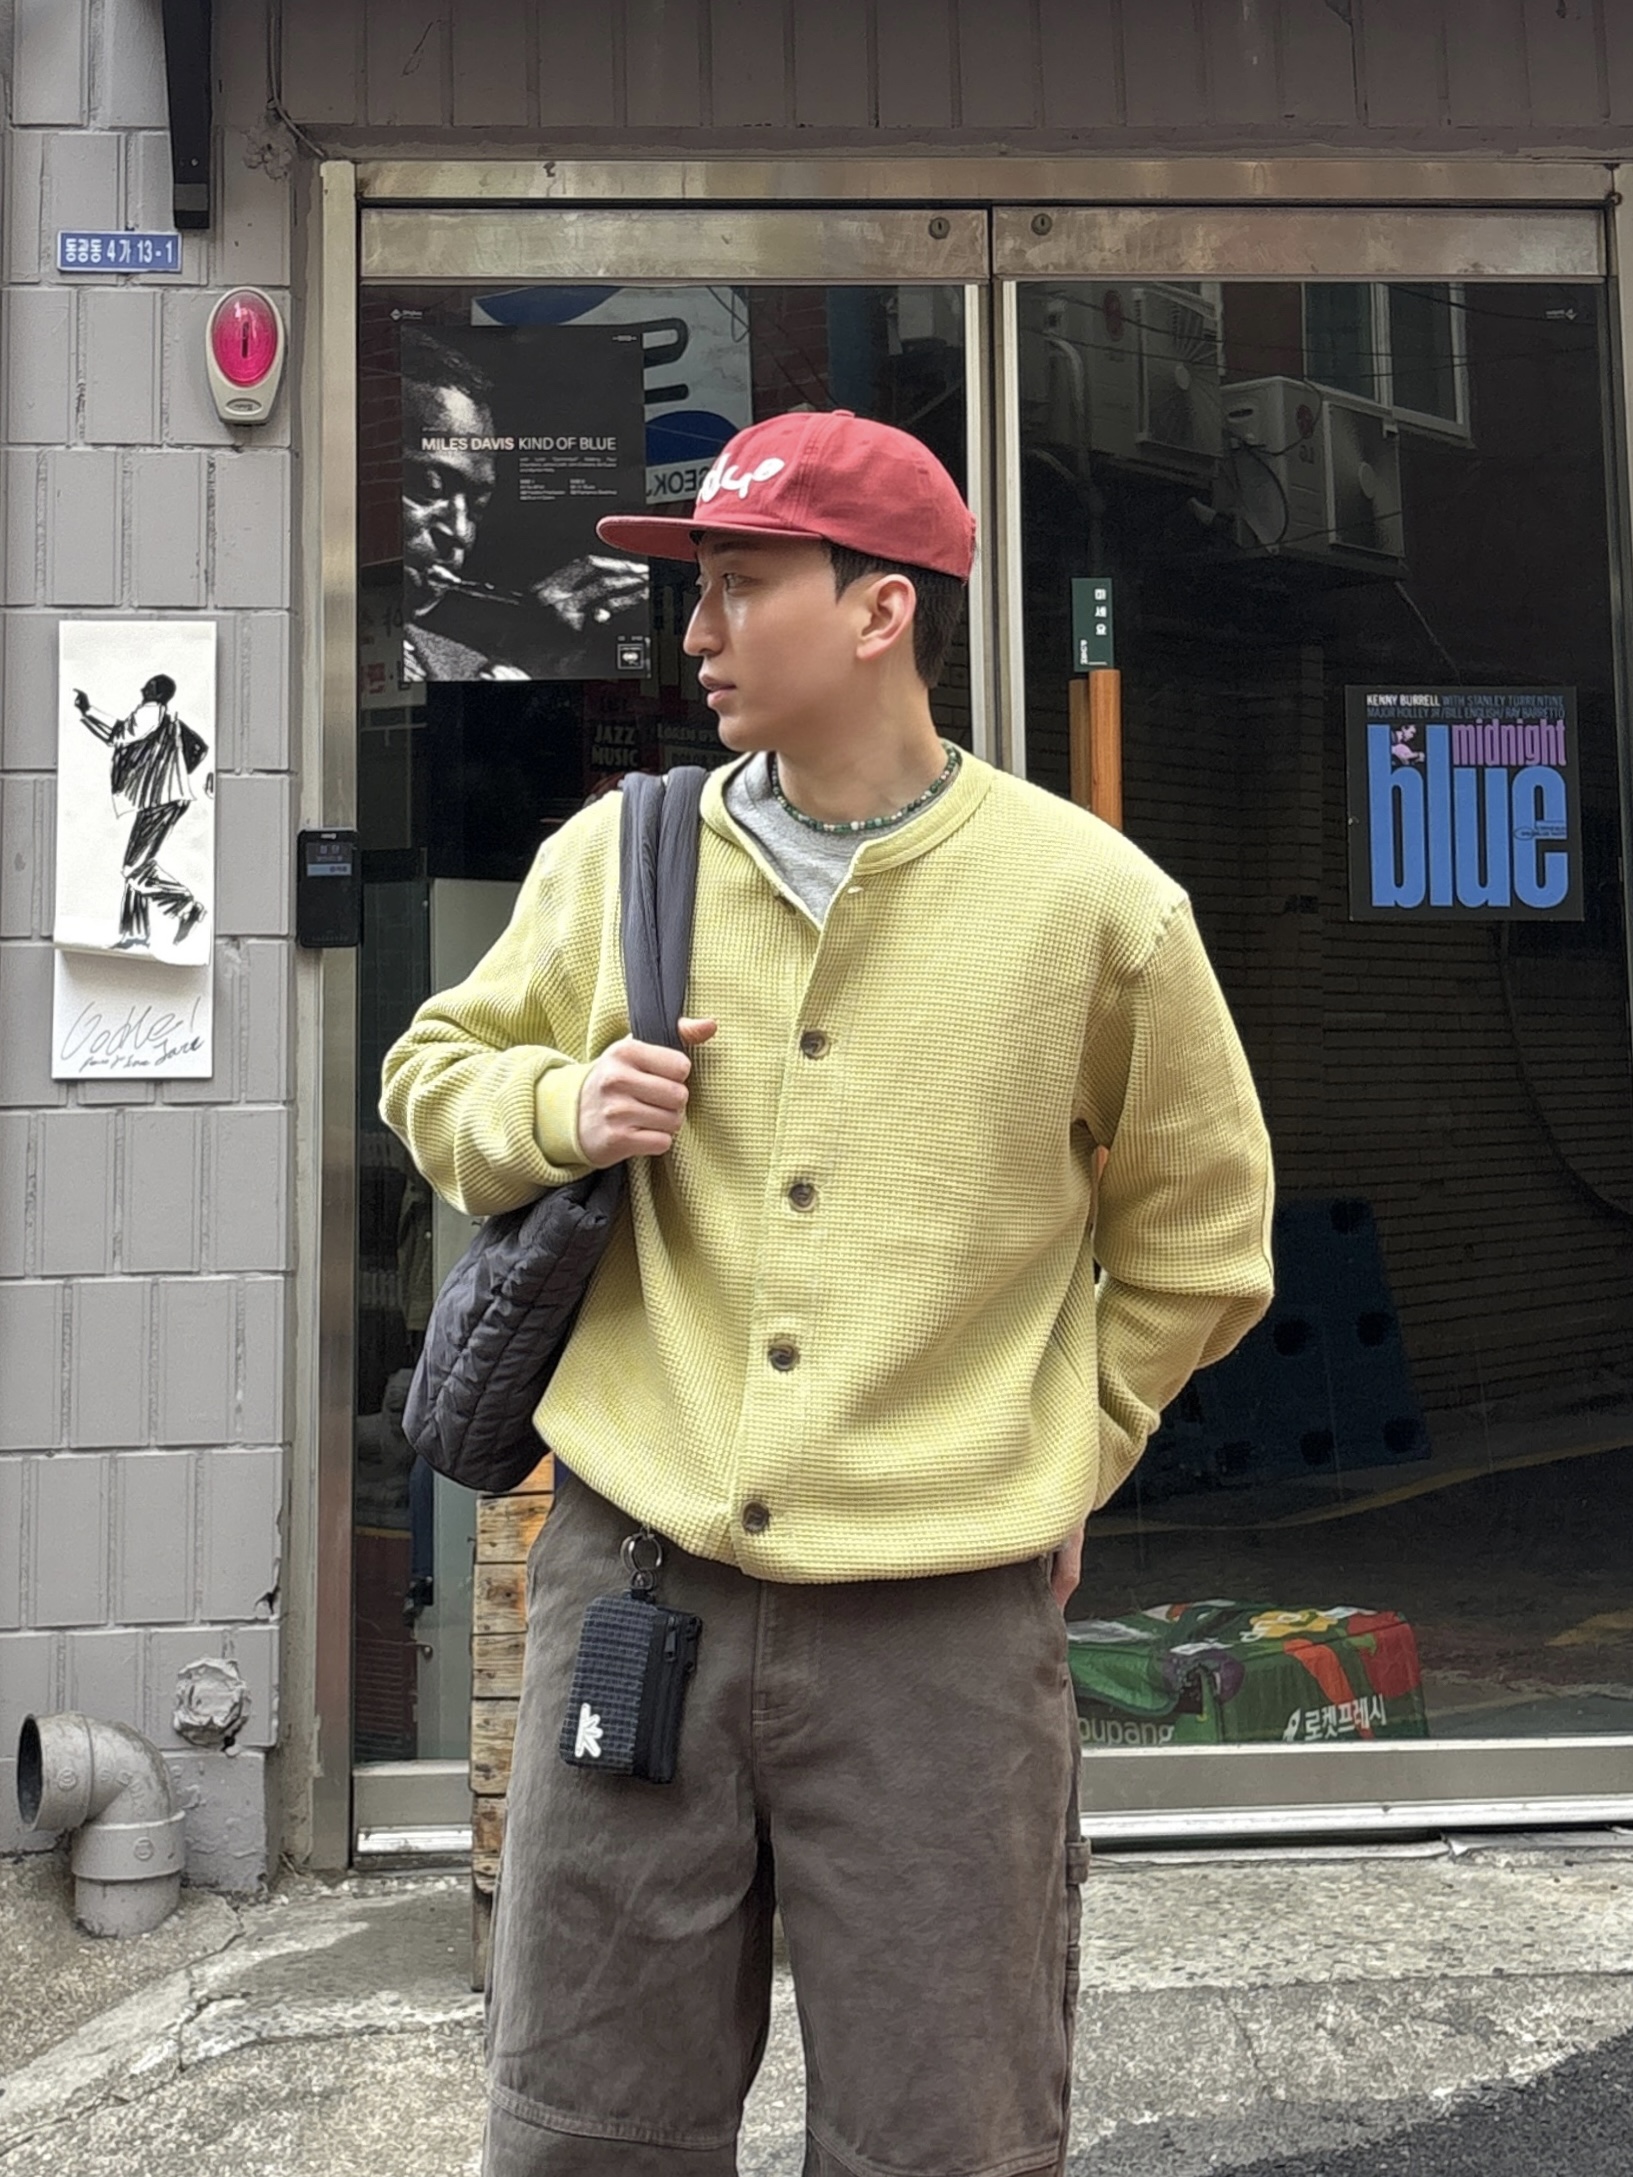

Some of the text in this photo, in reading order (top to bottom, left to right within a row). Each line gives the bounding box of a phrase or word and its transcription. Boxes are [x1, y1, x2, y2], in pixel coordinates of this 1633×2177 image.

[65, 238, 102, 263] 동광동
[107, 239, 131, 264] 4가
[421, 437, 617, 451] MILES DAVIS KIND OF BLUE
[1094, 588, 1107, 636] 미세요
[1366, 694, 1398, 706] KENNY
[1399, 694, 1440, 706] BURRELL
[594, 723, 636, 745] JAZZ
[1452, 718, 1567, 766] midnight
[591, 745, 639, 768] MUSIC
[1367, 723, 1568, 908] blue
[1304, 1693, 1387, 1741] 로켓프레시
[1078, 1717, 1175, 1746] oupang
